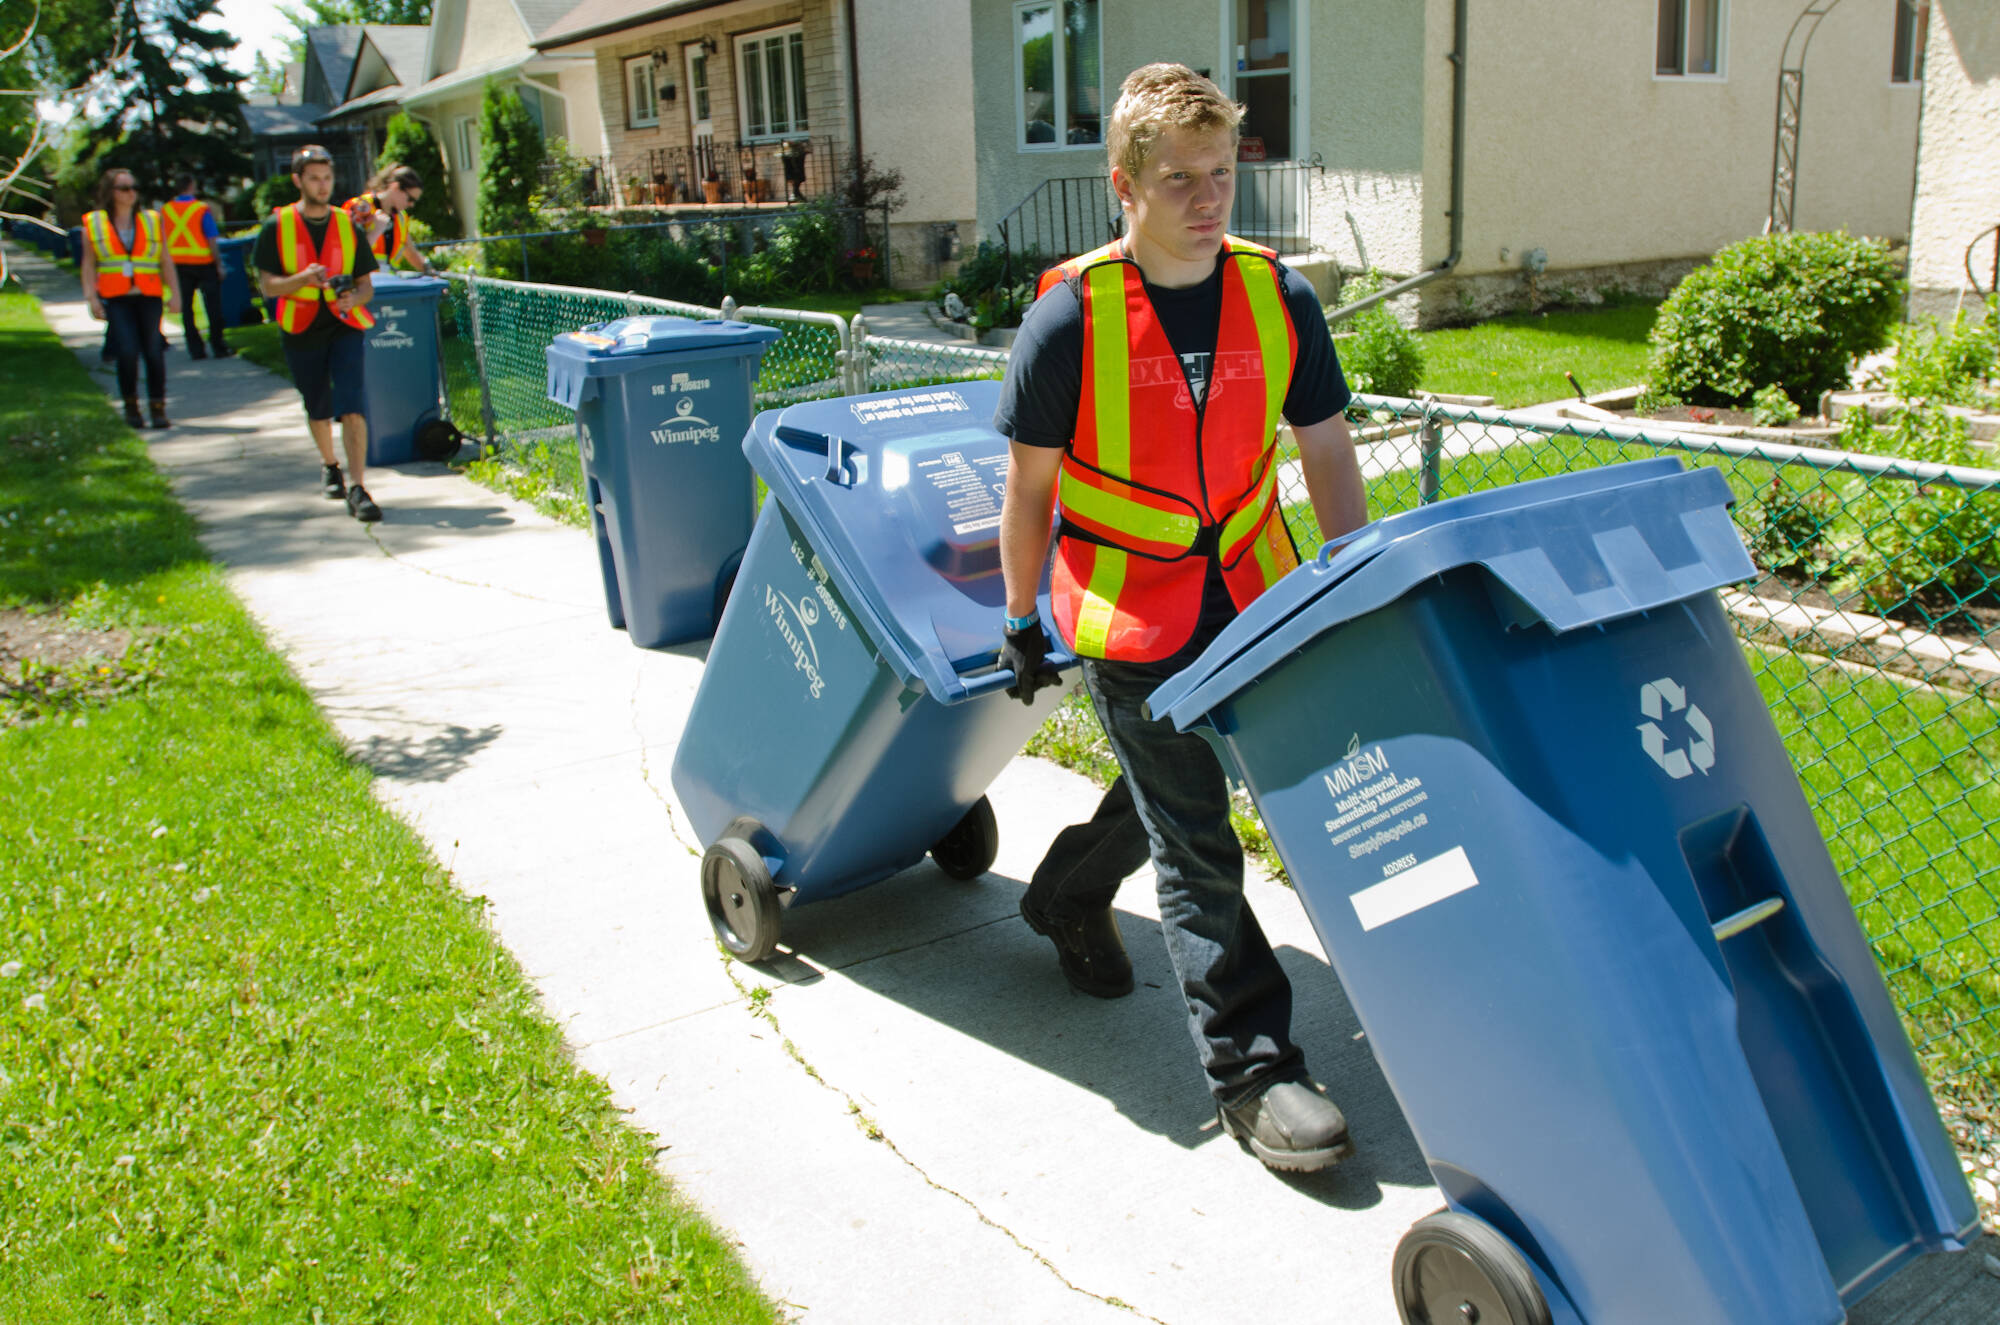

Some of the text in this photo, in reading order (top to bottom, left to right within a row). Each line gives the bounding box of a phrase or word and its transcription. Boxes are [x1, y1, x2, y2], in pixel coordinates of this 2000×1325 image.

[650, 425, 720, 445] Winnipeg
[765, 583, 825, 699] Winnipeg
[1323, 745, 1390, 798] MMSM
[1335, 772, 1399, 814] Multi-Material
[1325, 776, 1422, 833] Stewardship Manitoba
[1331, 791, 1428, 846] INDUSTRY FUNDING RECYCLING
[1348, 812, 1429, 859] SimplyRecycle.ca
[1382, 853, 1418, 877] ADDRESS
